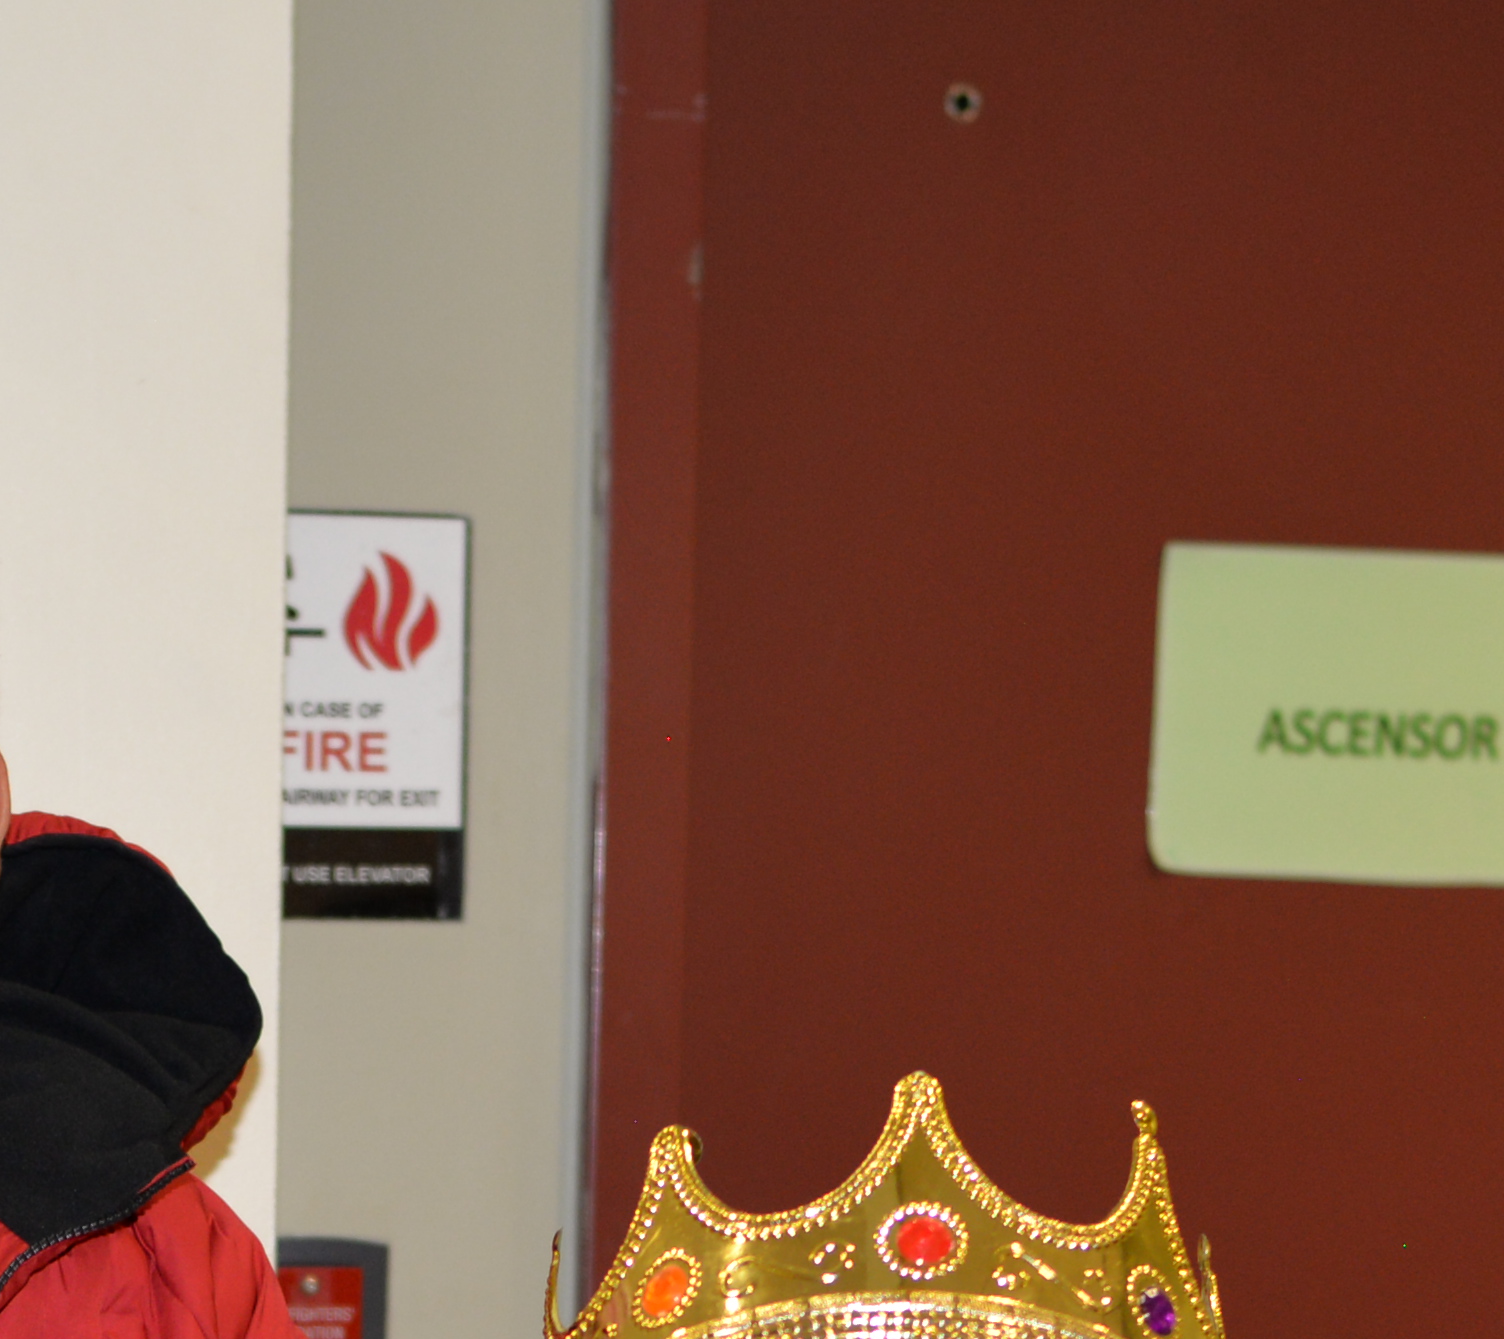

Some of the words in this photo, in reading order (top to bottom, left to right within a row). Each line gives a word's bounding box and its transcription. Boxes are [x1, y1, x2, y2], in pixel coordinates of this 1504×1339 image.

[300, 702, 351, 719] CASE
[358, 703, 384, 719] OF
[1258, 708, 1500, 761] ASCENSOR
[283, 789, 350, 807] AIRWAY
[356, 789, 396, 807] FOR
[400, 790, 441, 808] EXIT
[293, 865, 330, 885] USE
[333, 865, 431, 886] ELEVATOR
[288, 1306, 355, 1323] FIGHTERS'
